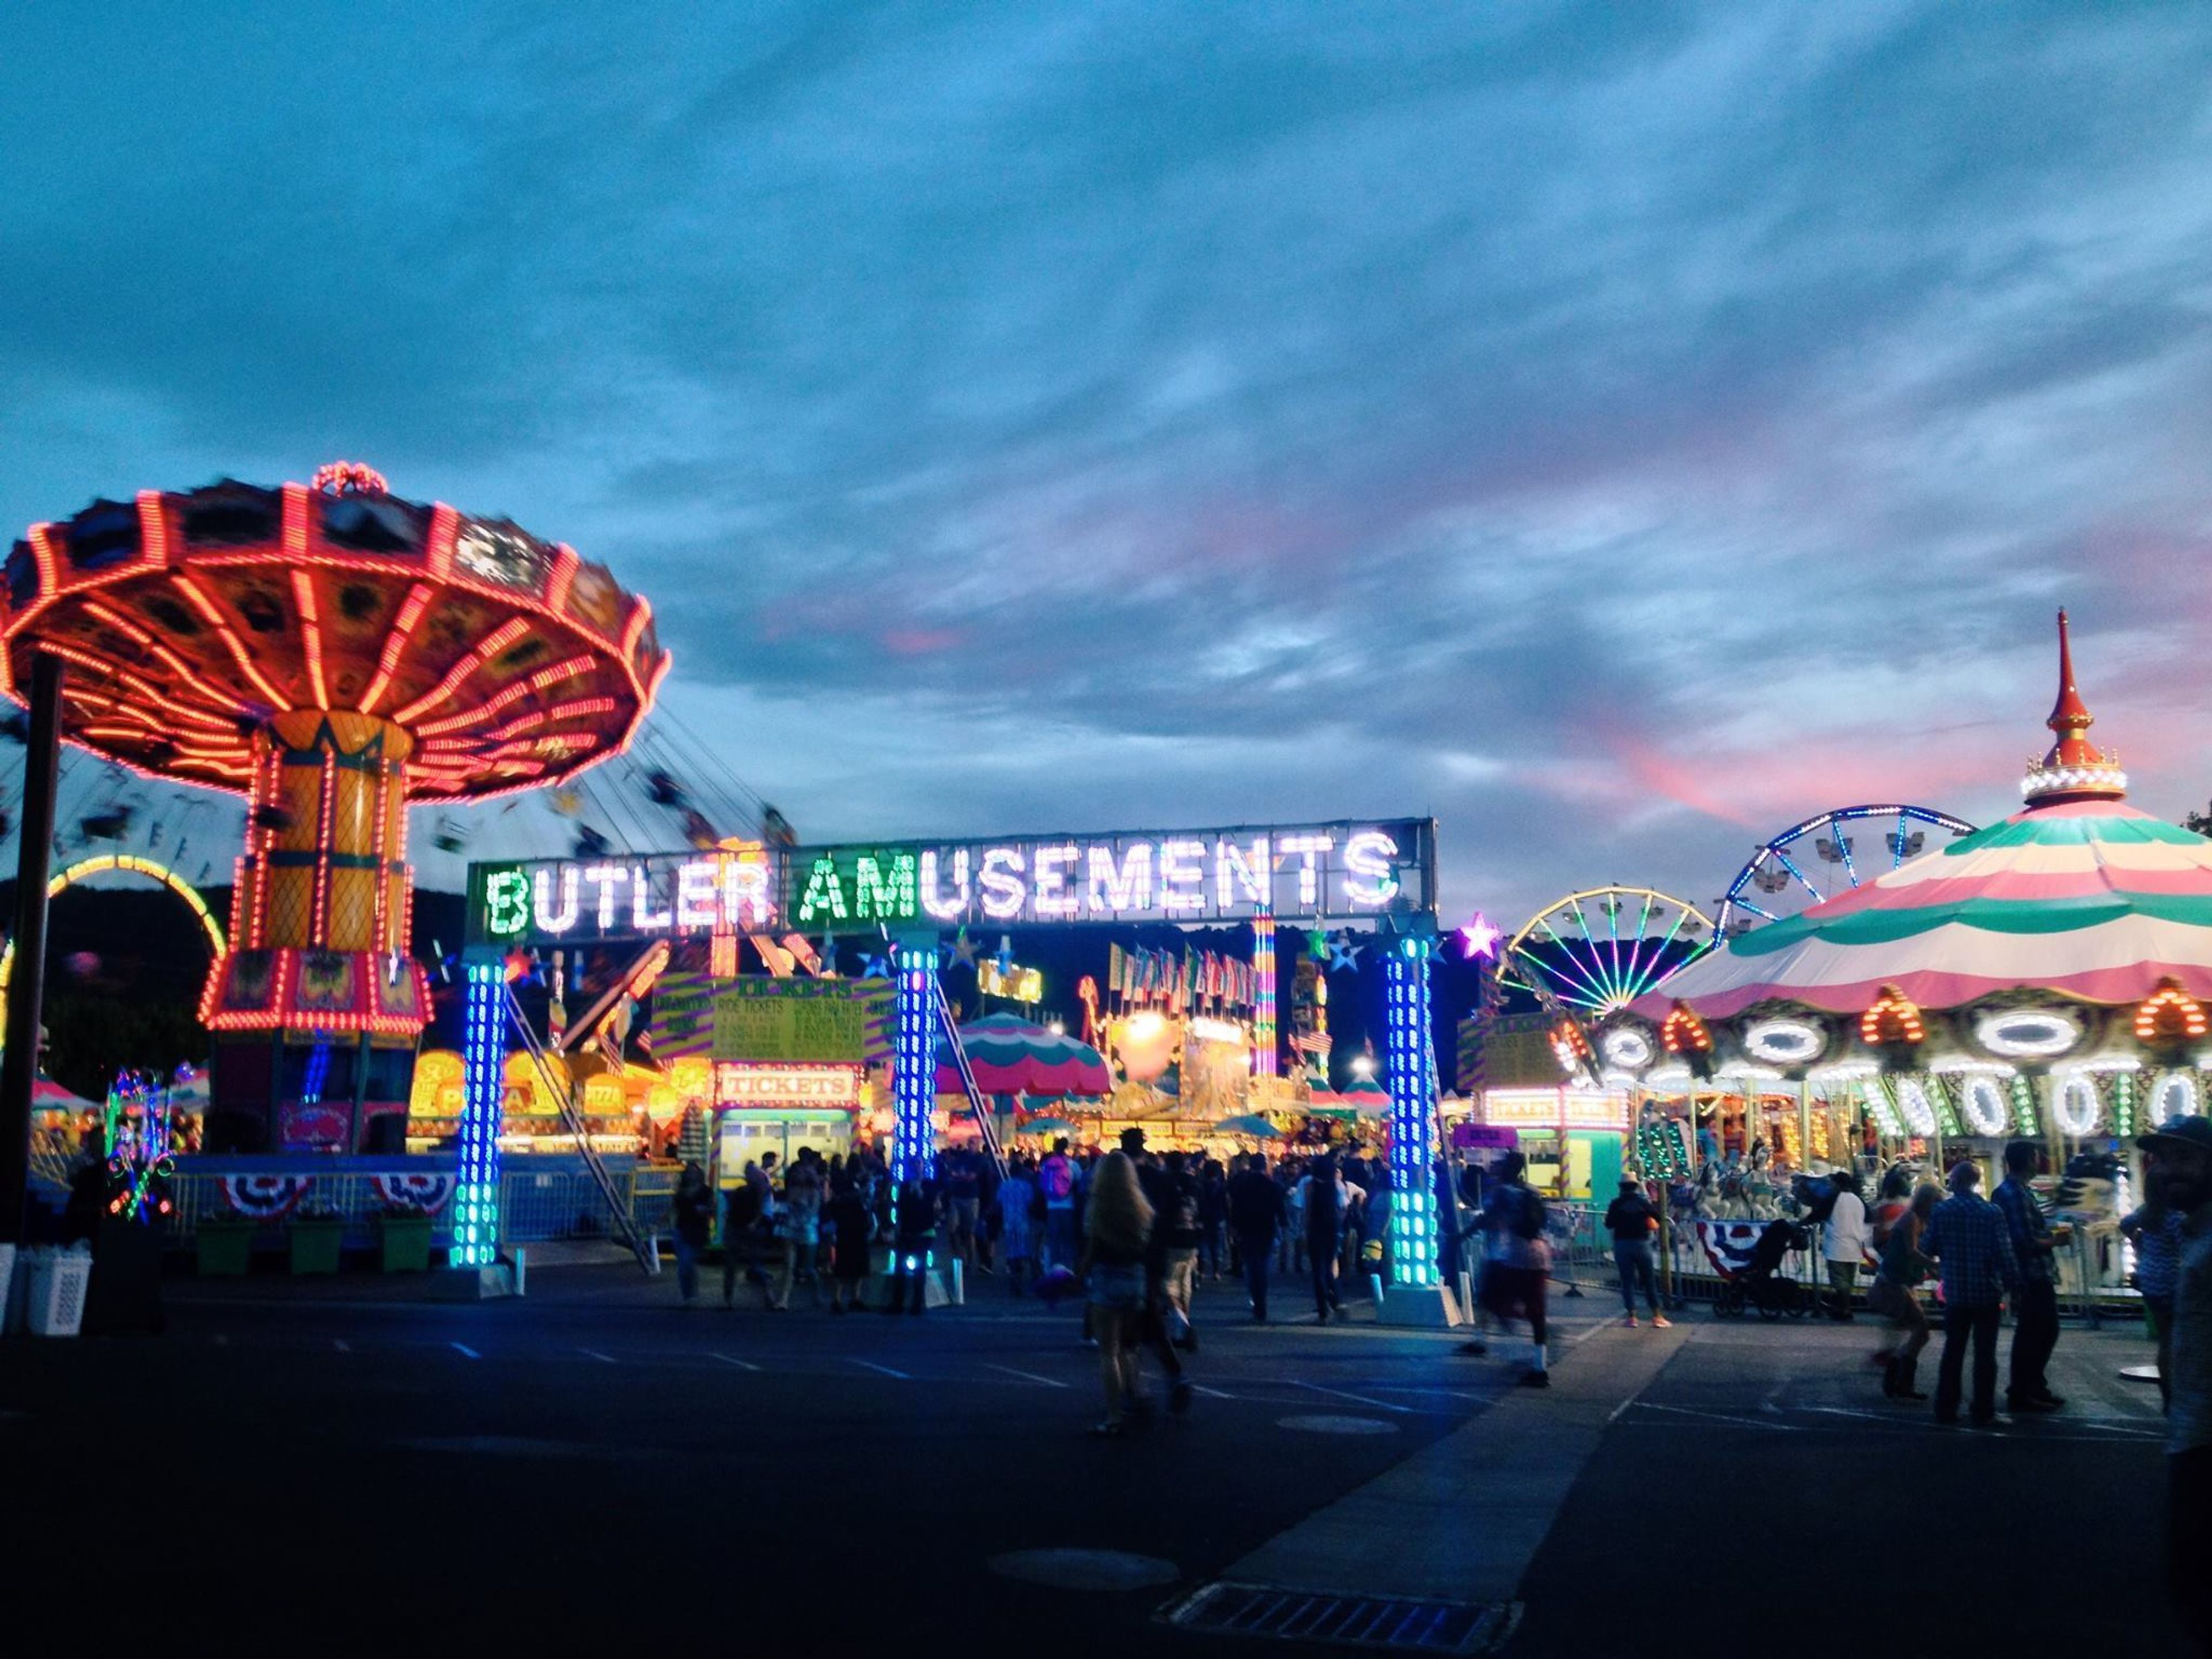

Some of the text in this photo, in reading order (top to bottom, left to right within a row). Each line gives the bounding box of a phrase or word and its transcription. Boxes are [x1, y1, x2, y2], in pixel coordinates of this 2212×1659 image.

[487, 833, 1399, 933] BUTLER AMUSEMENTS
[738, 977, 852, 998] TICKETS
[744, 999, 784, 1014] TICKETS
[729, 1077, 846, 1094] TICKETS
[586, 1086, 622, 1105] PIZZA
